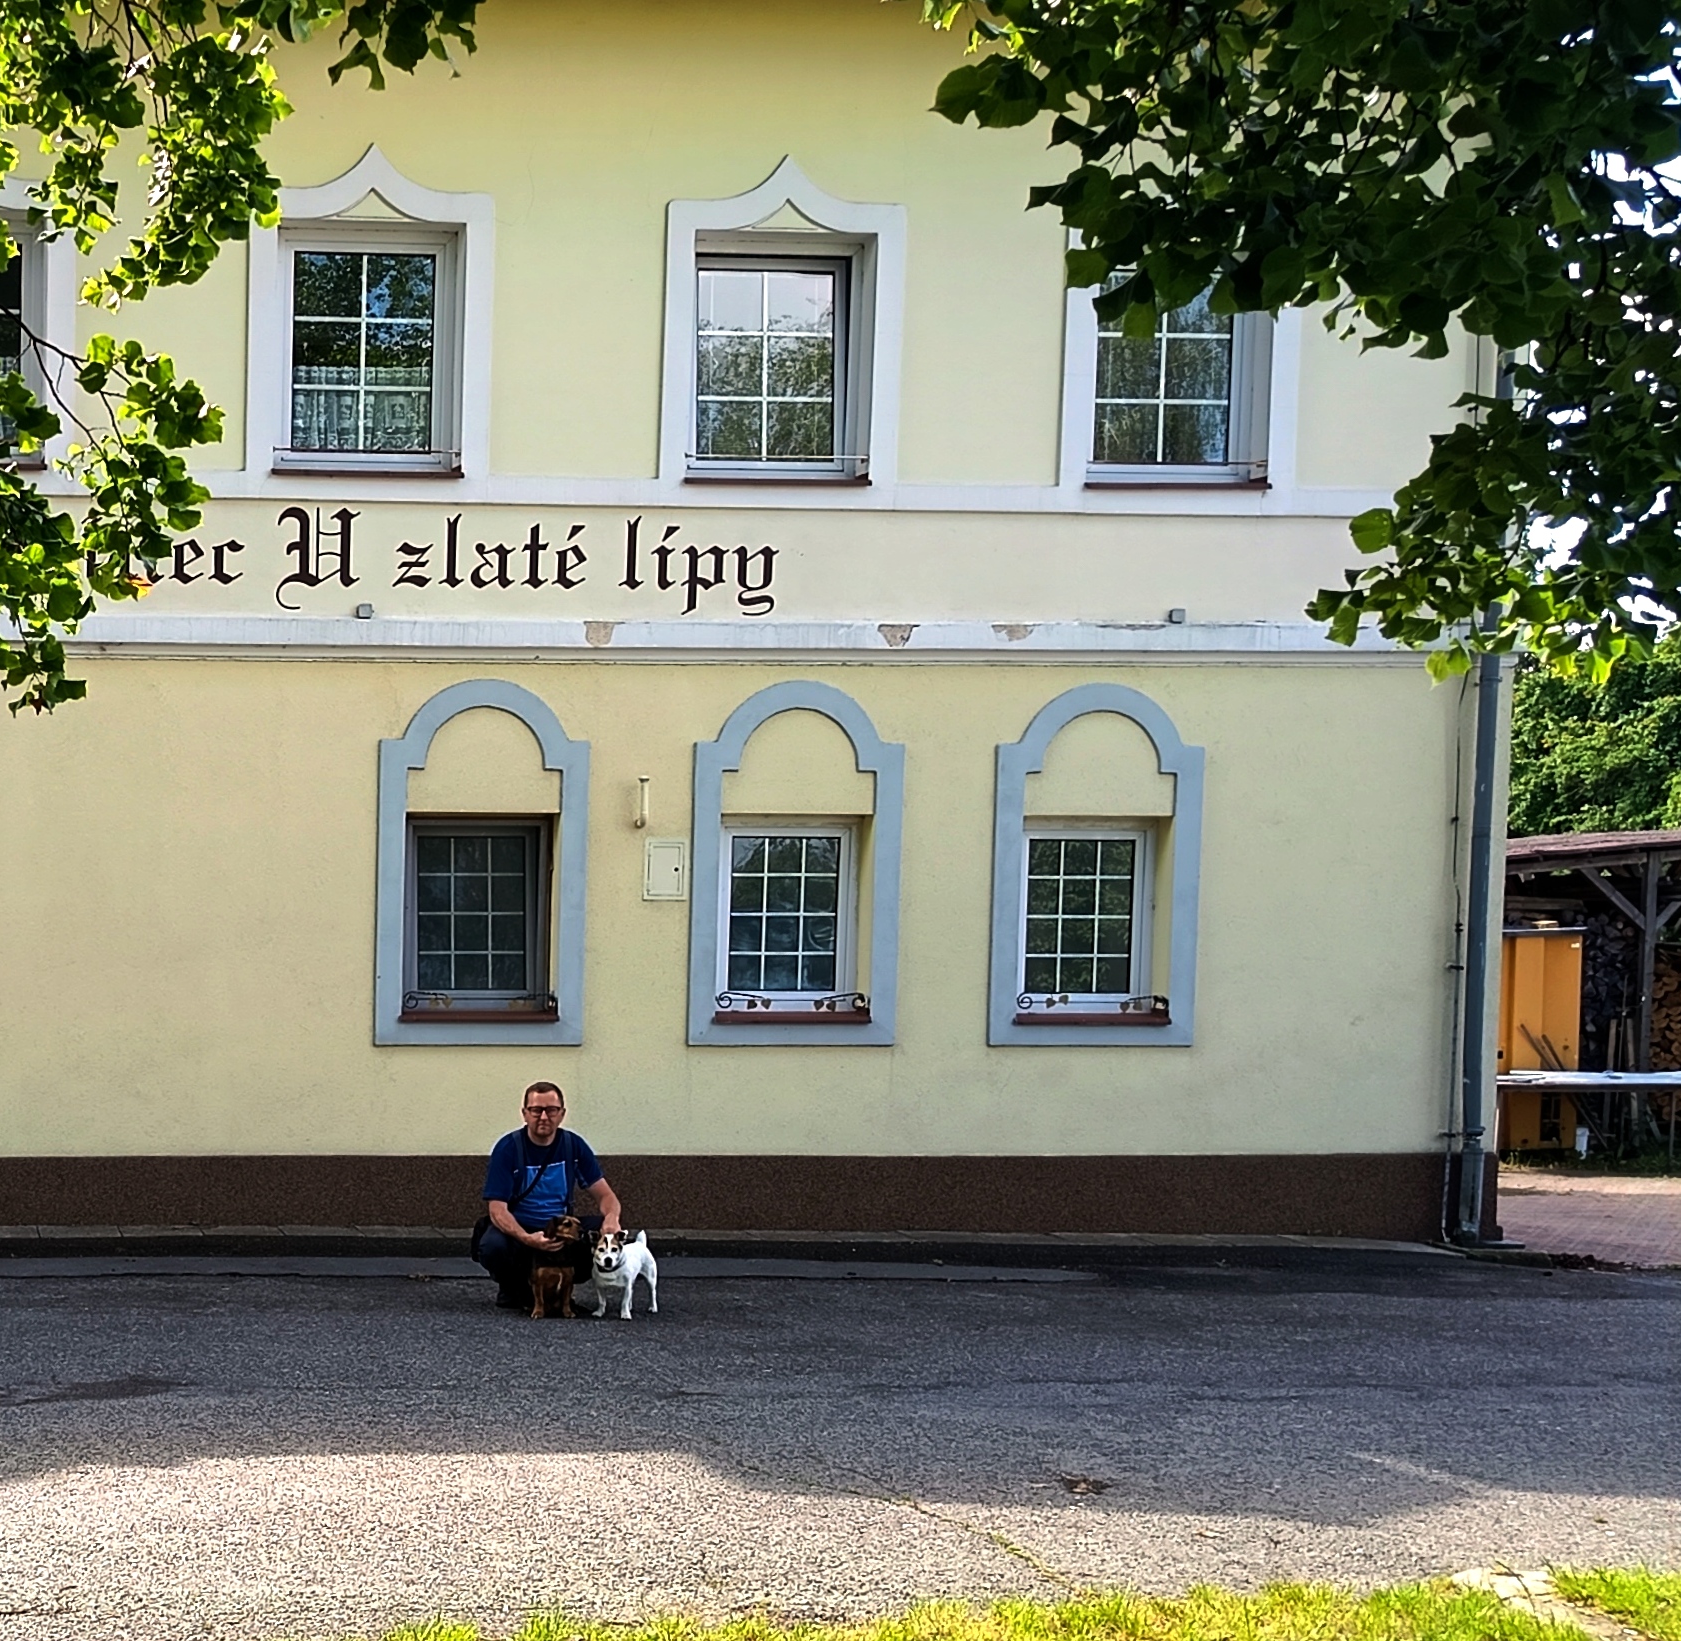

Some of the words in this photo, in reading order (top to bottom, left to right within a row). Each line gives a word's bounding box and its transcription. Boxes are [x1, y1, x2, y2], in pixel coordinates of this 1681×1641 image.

[275, 506, 361, 610] U
[392, 513, 588, 590] zlaté
[617, 515, 780, 616] lípy
